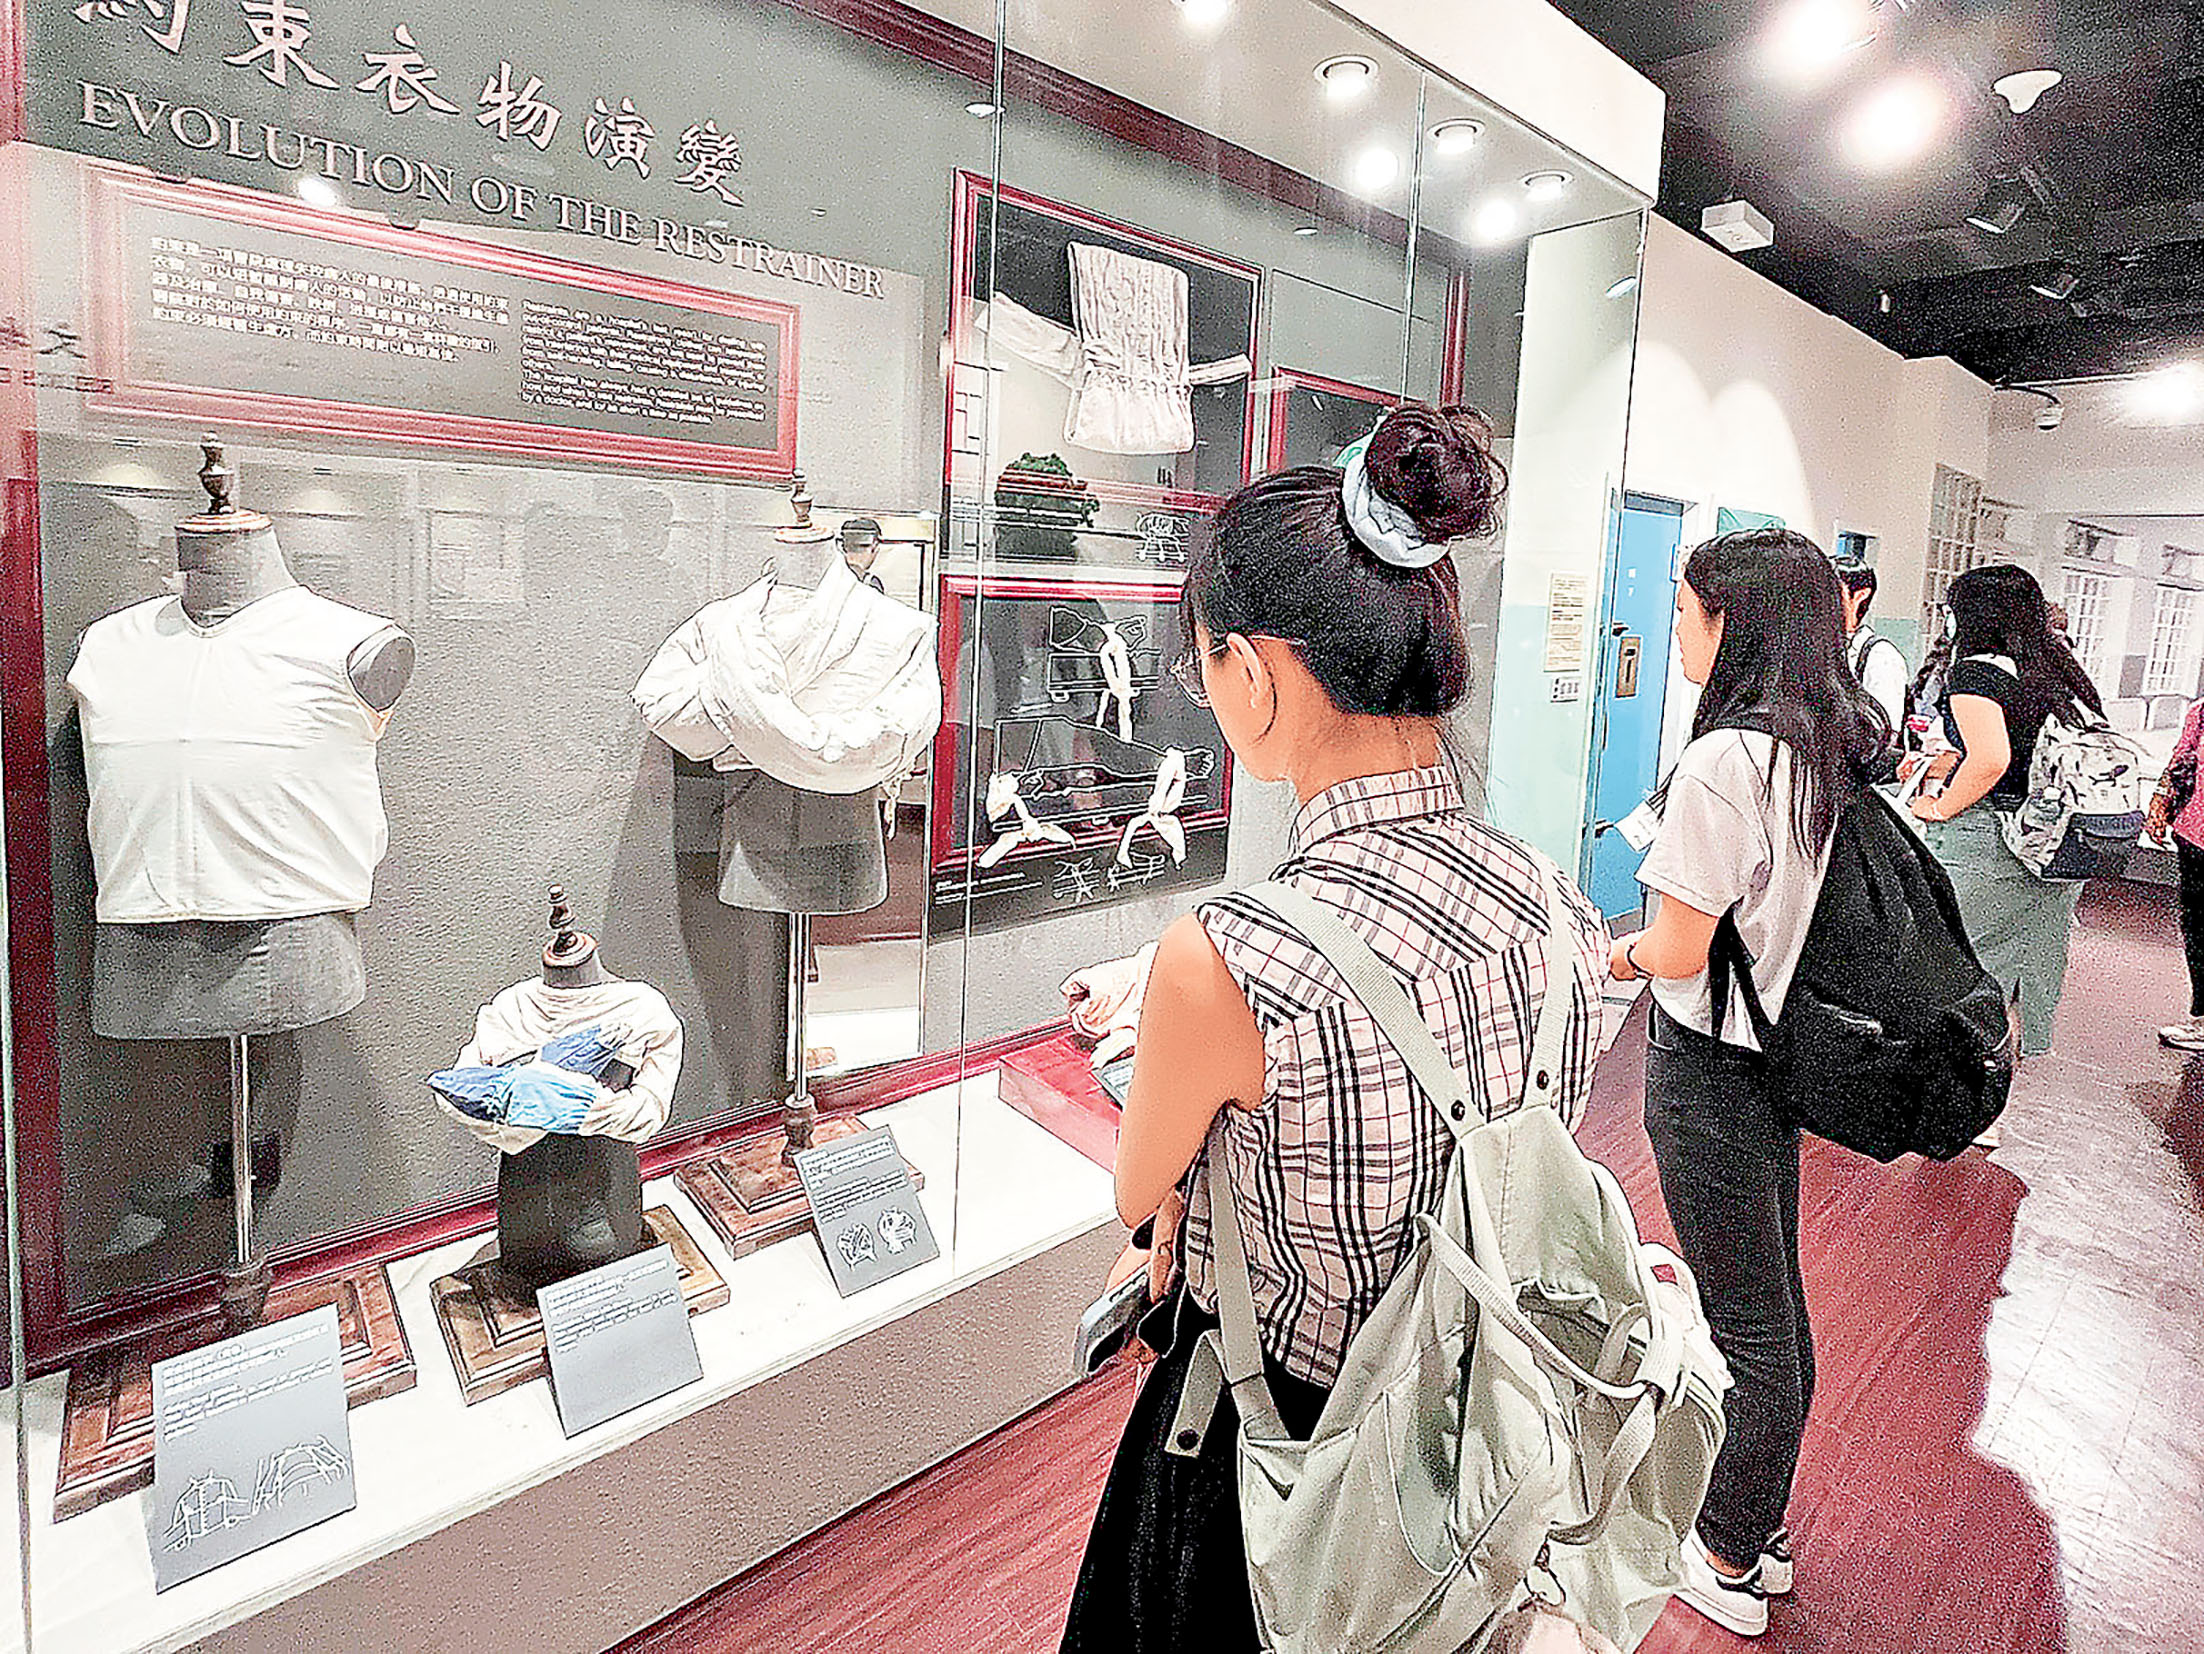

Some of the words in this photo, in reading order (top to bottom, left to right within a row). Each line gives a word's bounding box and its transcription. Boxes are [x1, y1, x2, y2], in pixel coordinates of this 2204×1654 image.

[77, 79, 454, 204] EVOLUTION
[471, 176, 538, 221] OF
[548, 192, 643, 246] THE
[653, 216, 885, 299] RESTRAINER
